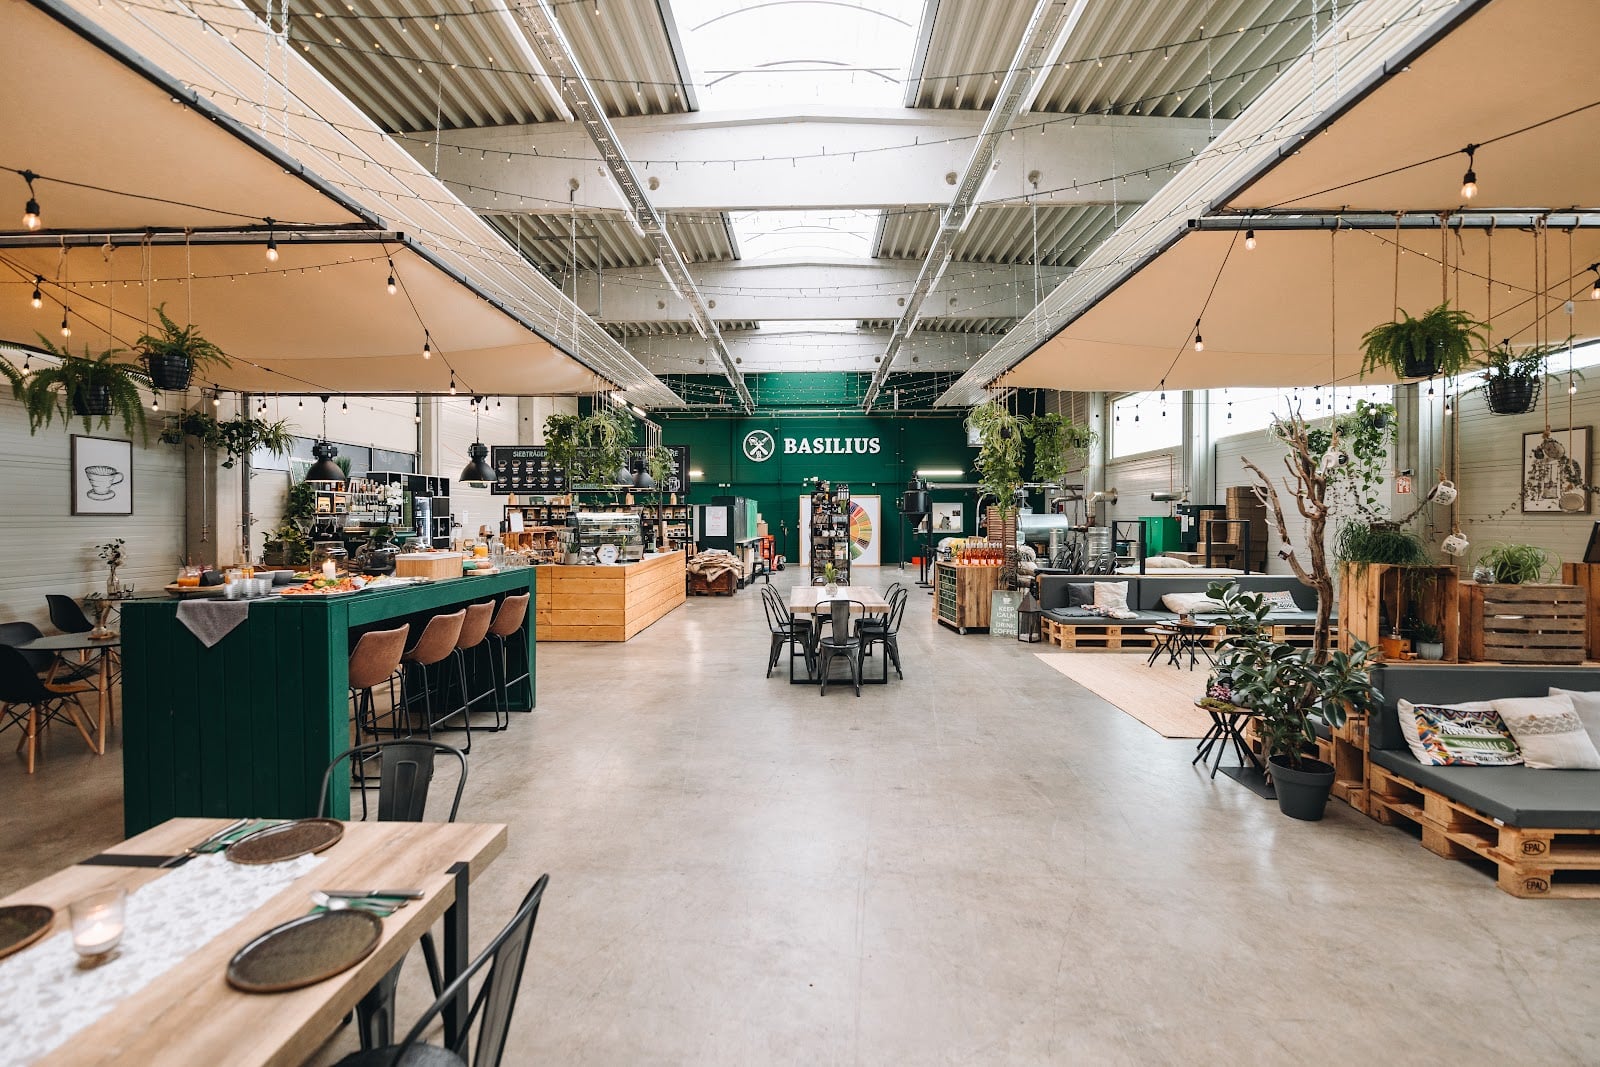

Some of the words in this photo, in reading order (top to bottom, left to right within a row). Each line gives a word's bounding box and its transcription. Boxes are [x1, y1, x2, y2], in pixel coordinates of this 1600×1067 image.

[783, 437, 880, 454] BASILIUS
[992, 628, 1018, 636] COFFEE
[1524, 843, 1541, 852] EPAL
[1526, 880, 1543, 891] EPAL
